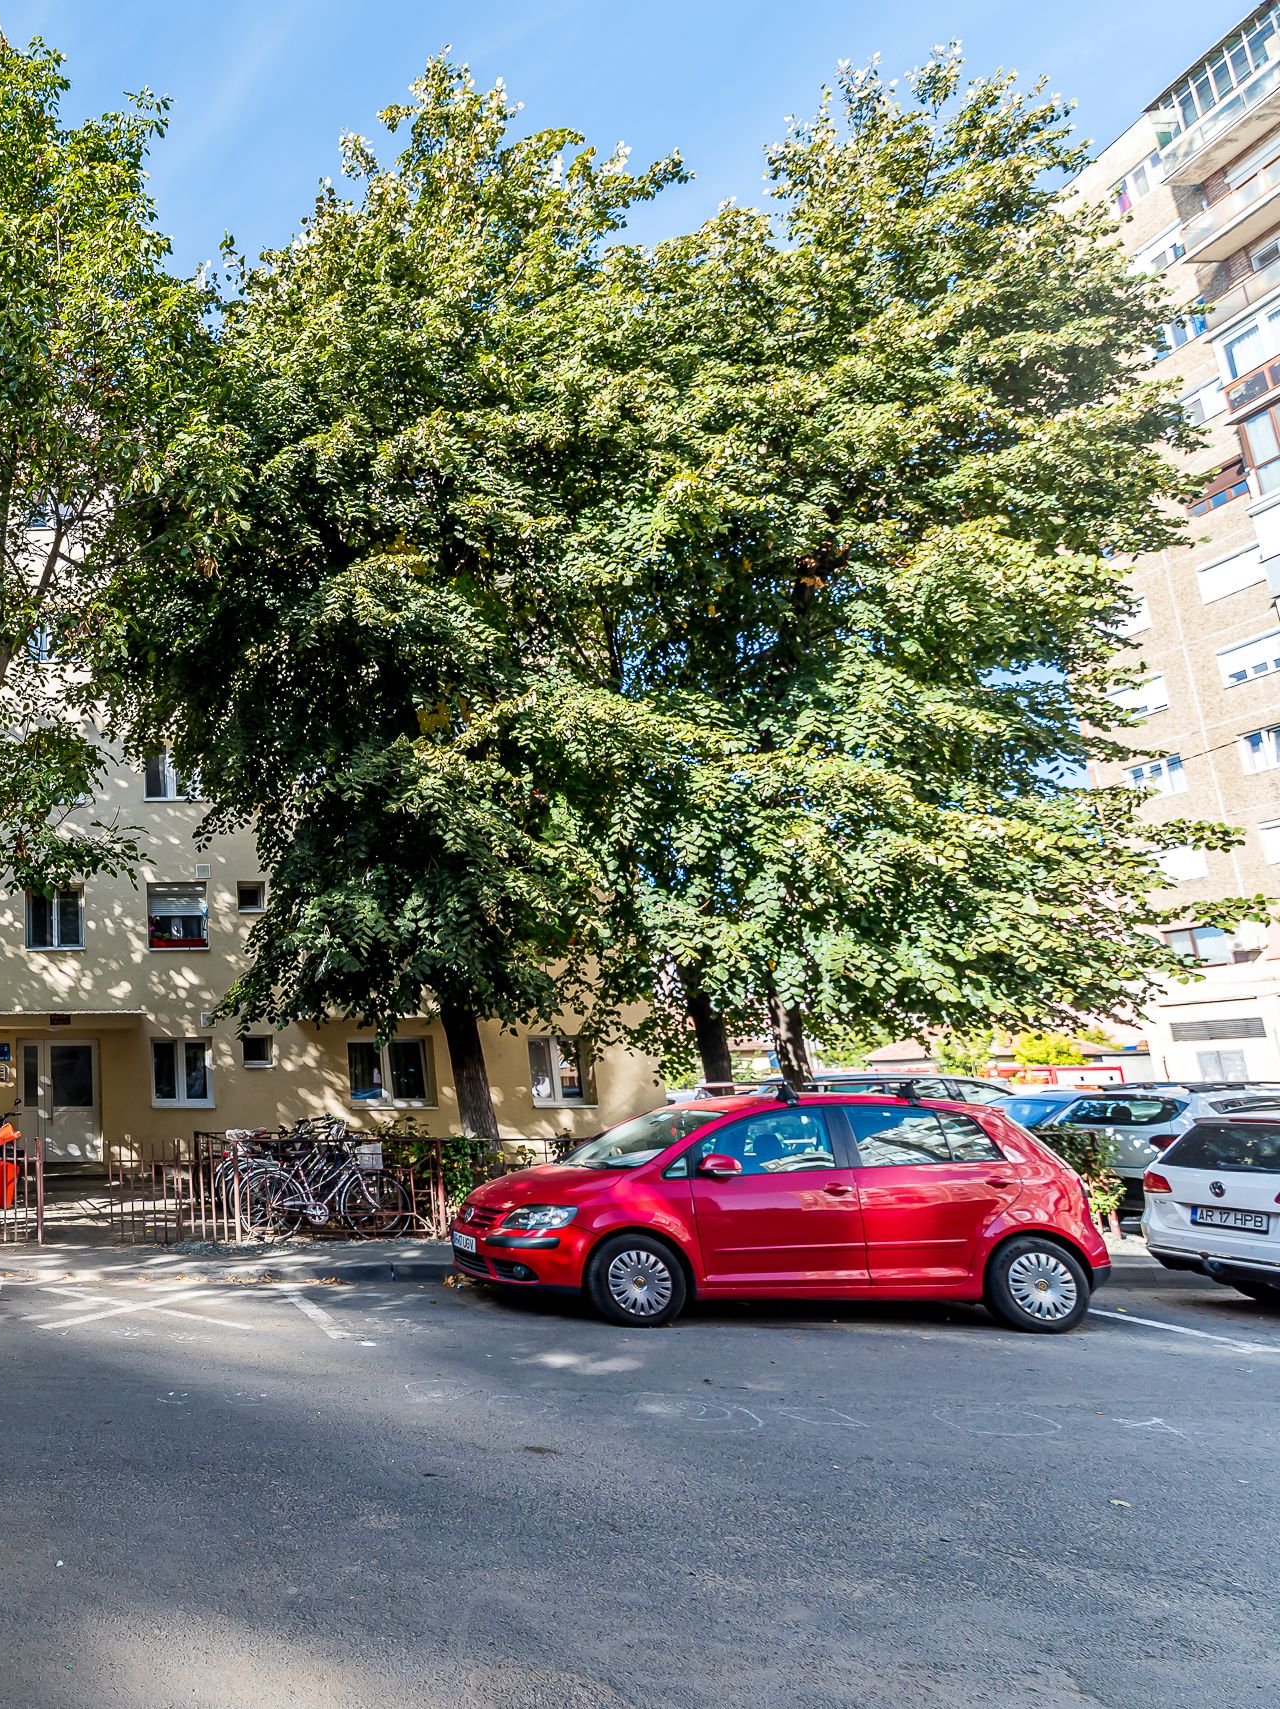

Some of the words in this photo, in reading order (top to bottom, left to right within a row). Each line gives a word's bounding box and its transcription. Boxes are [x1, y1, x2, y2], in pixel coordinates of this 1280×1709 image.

[1198, 1209, 1214, 1222] AR
[1219, 1212, 1231, 1224] 17
[1233, 1213, 1264, 1228] HPB
